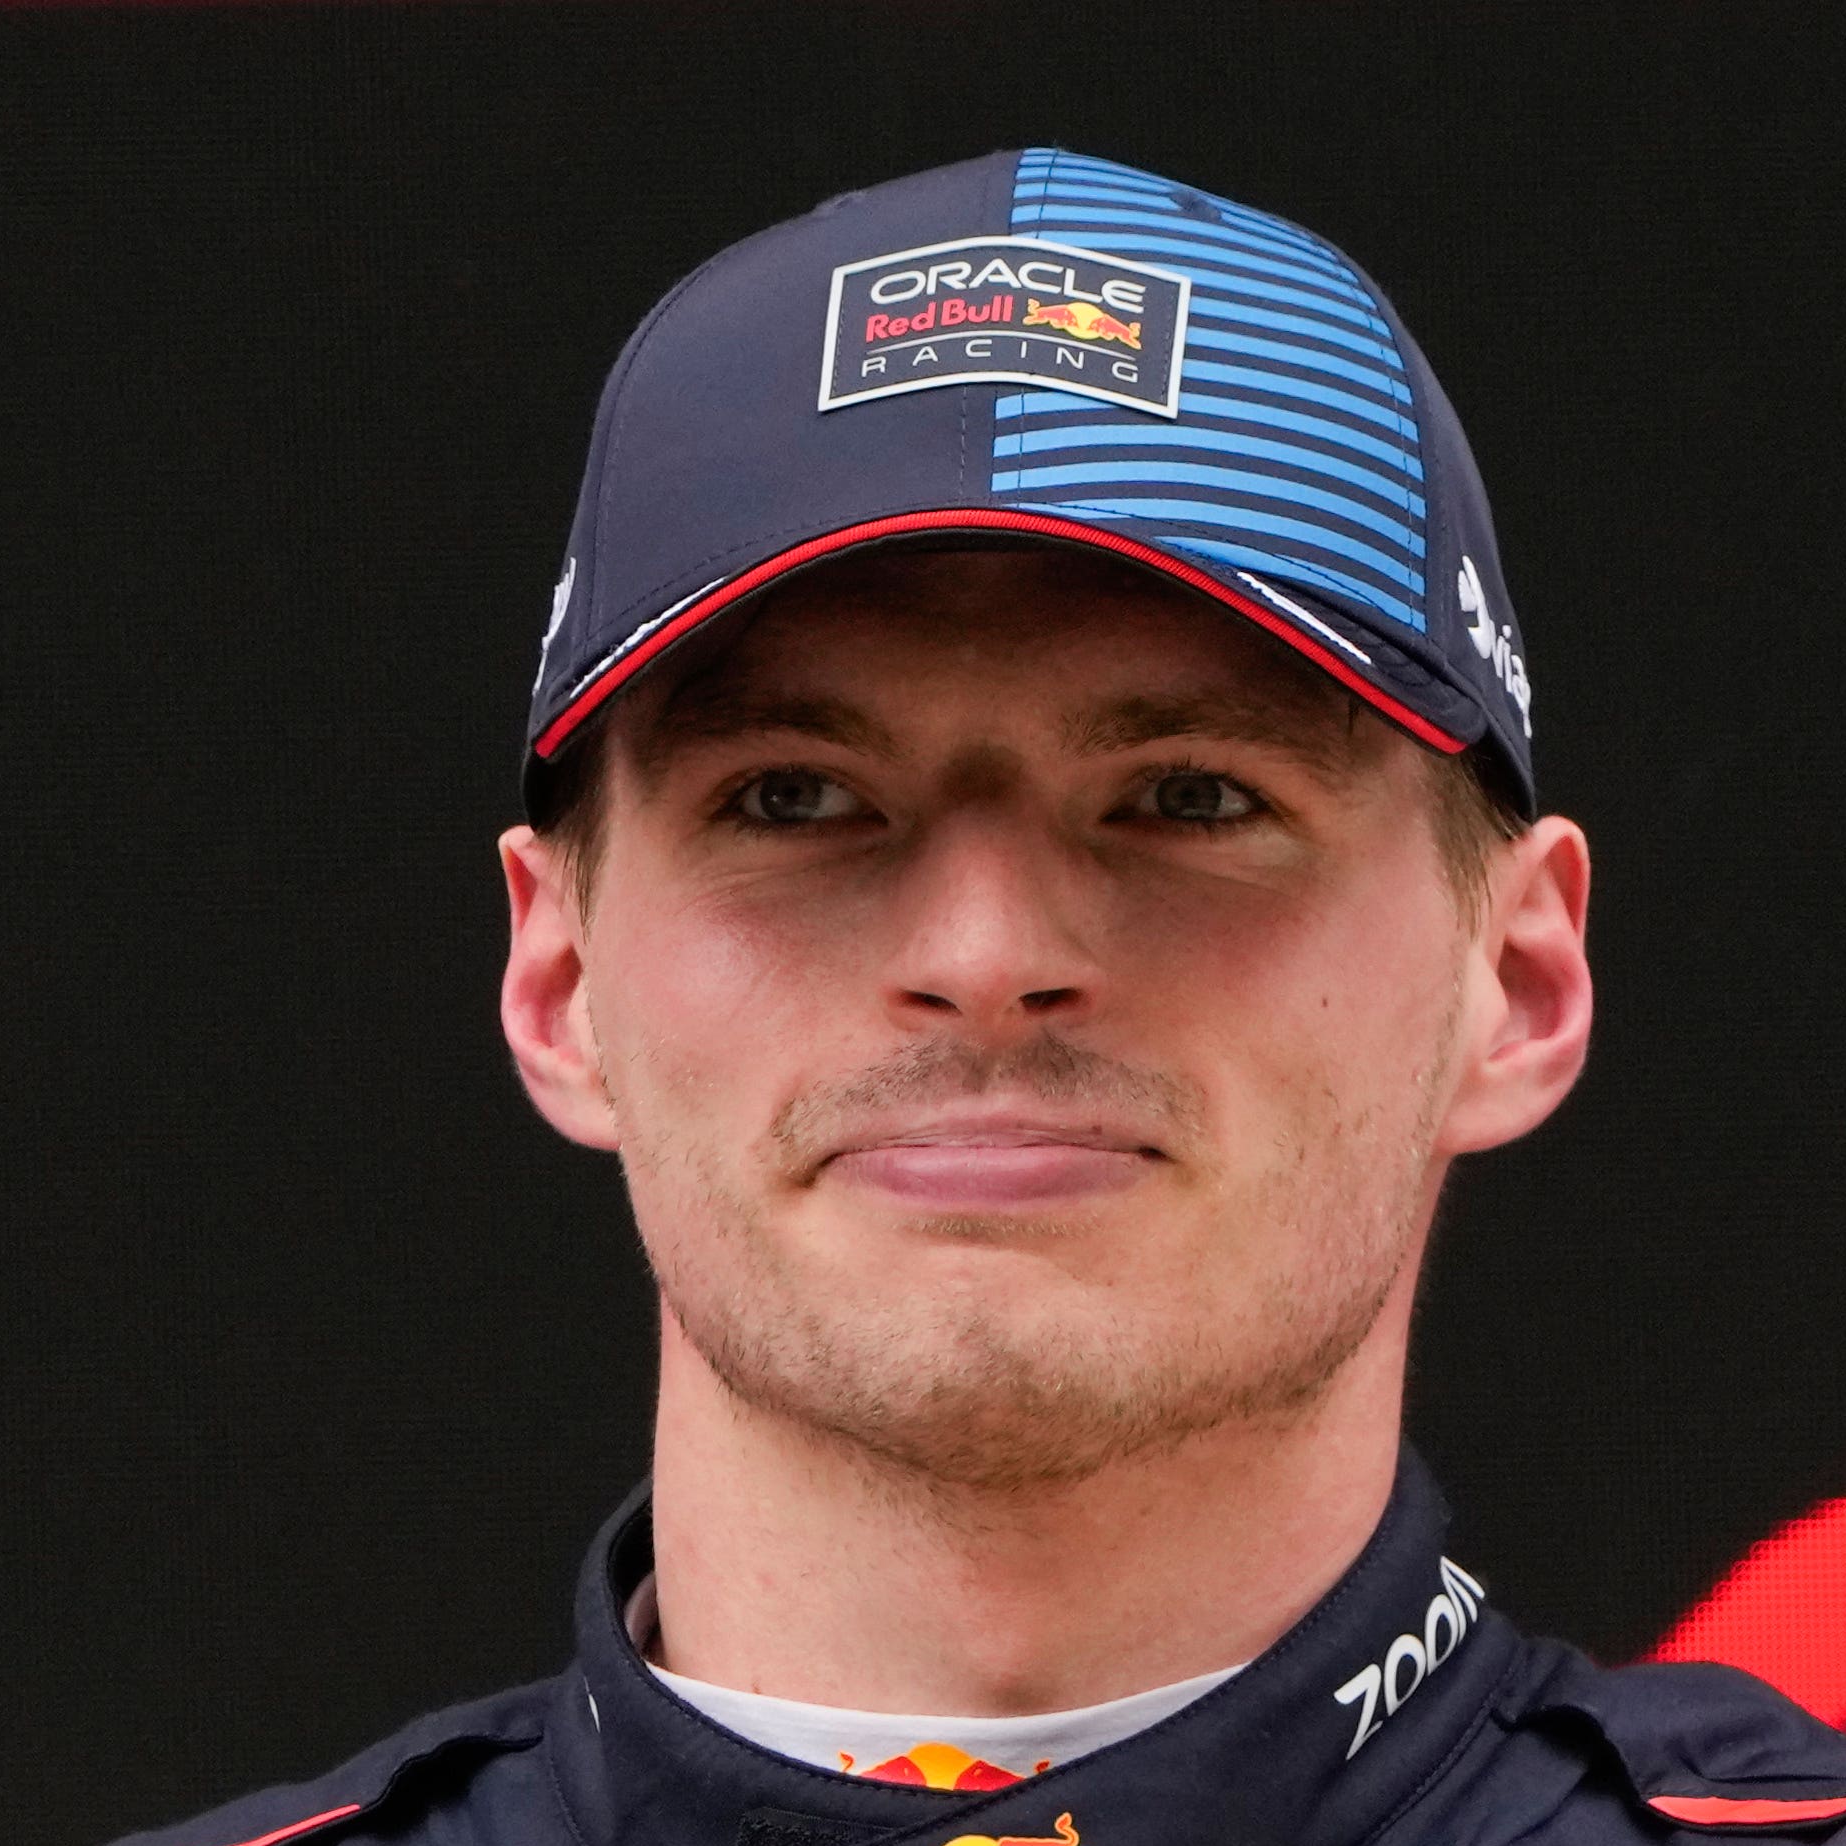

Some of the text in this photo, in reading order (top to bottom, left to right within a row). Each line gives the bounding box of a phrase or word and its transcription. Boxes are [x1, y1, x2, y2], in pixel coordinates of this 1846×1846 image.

[870, 258, 1146, 314] ORACLE
[865, 295, 1014, 342] Red Bull
[861, 338, 1139, 384] RACING
